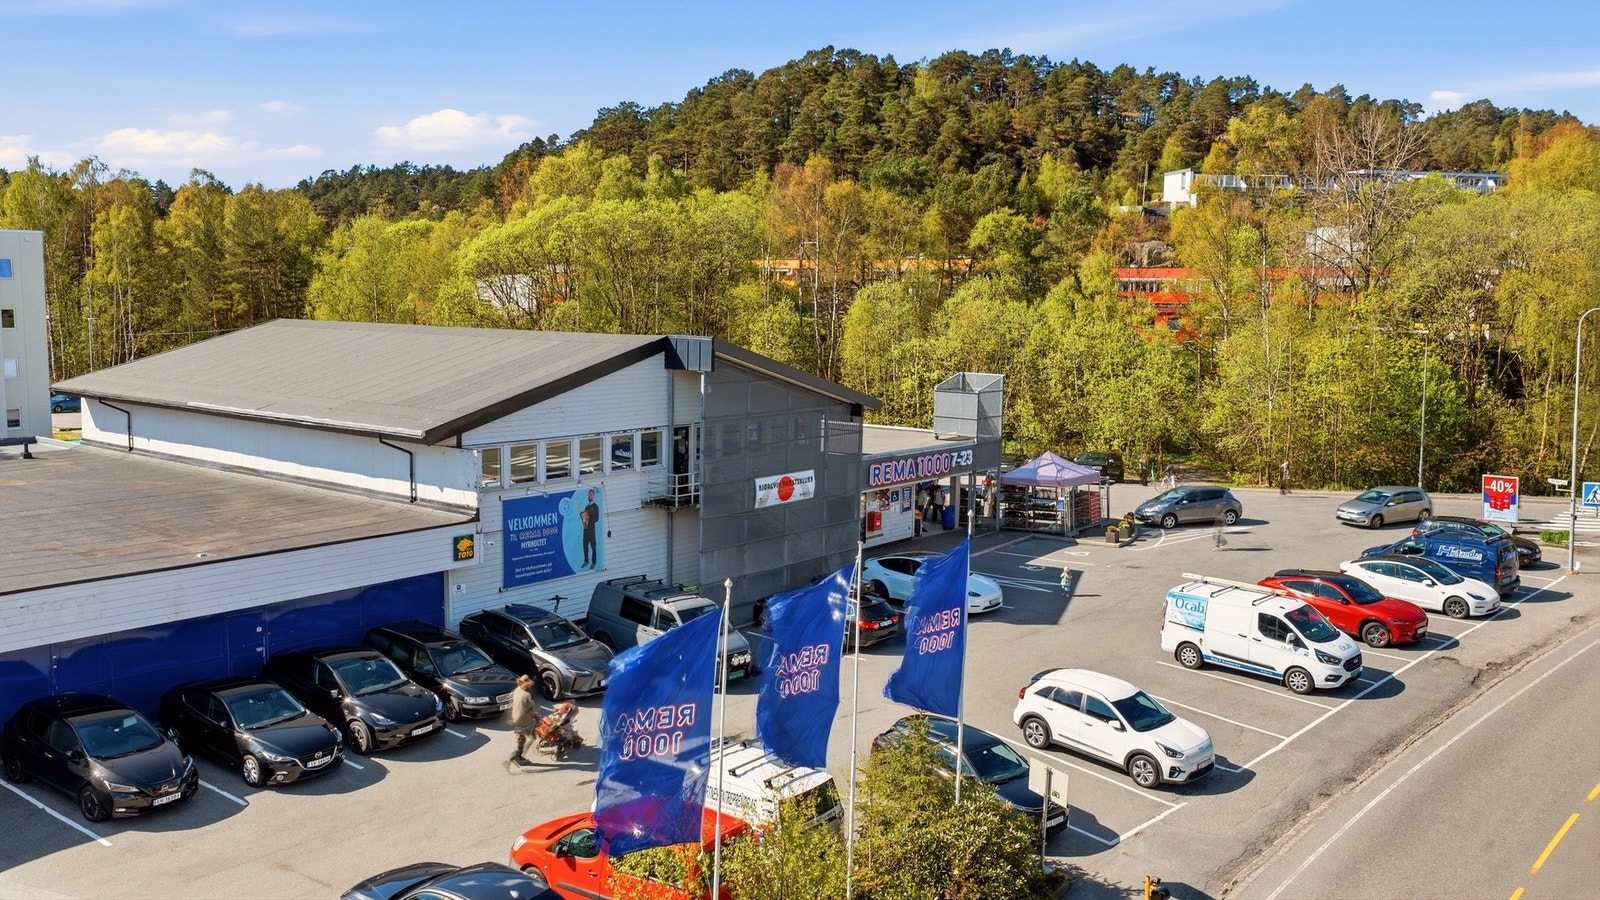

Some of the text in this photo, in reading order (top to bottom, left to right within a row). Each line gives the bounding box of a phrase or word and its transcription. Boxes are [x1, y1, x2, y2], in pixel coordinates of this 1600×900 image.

[951, 449, 973, 468] 7-23
[870, 452, 951, 487] REMA 1000
[1485, 480, 1514, 494] -40%
[508, 512, 558, 532] VELKOMMEN
[519, 530, 542, 541] REMA
[542, 526, 559, 537] 1000
[458, 550, 474, 558] TOTO
[1175, 597, 1205, 614] Ocab
